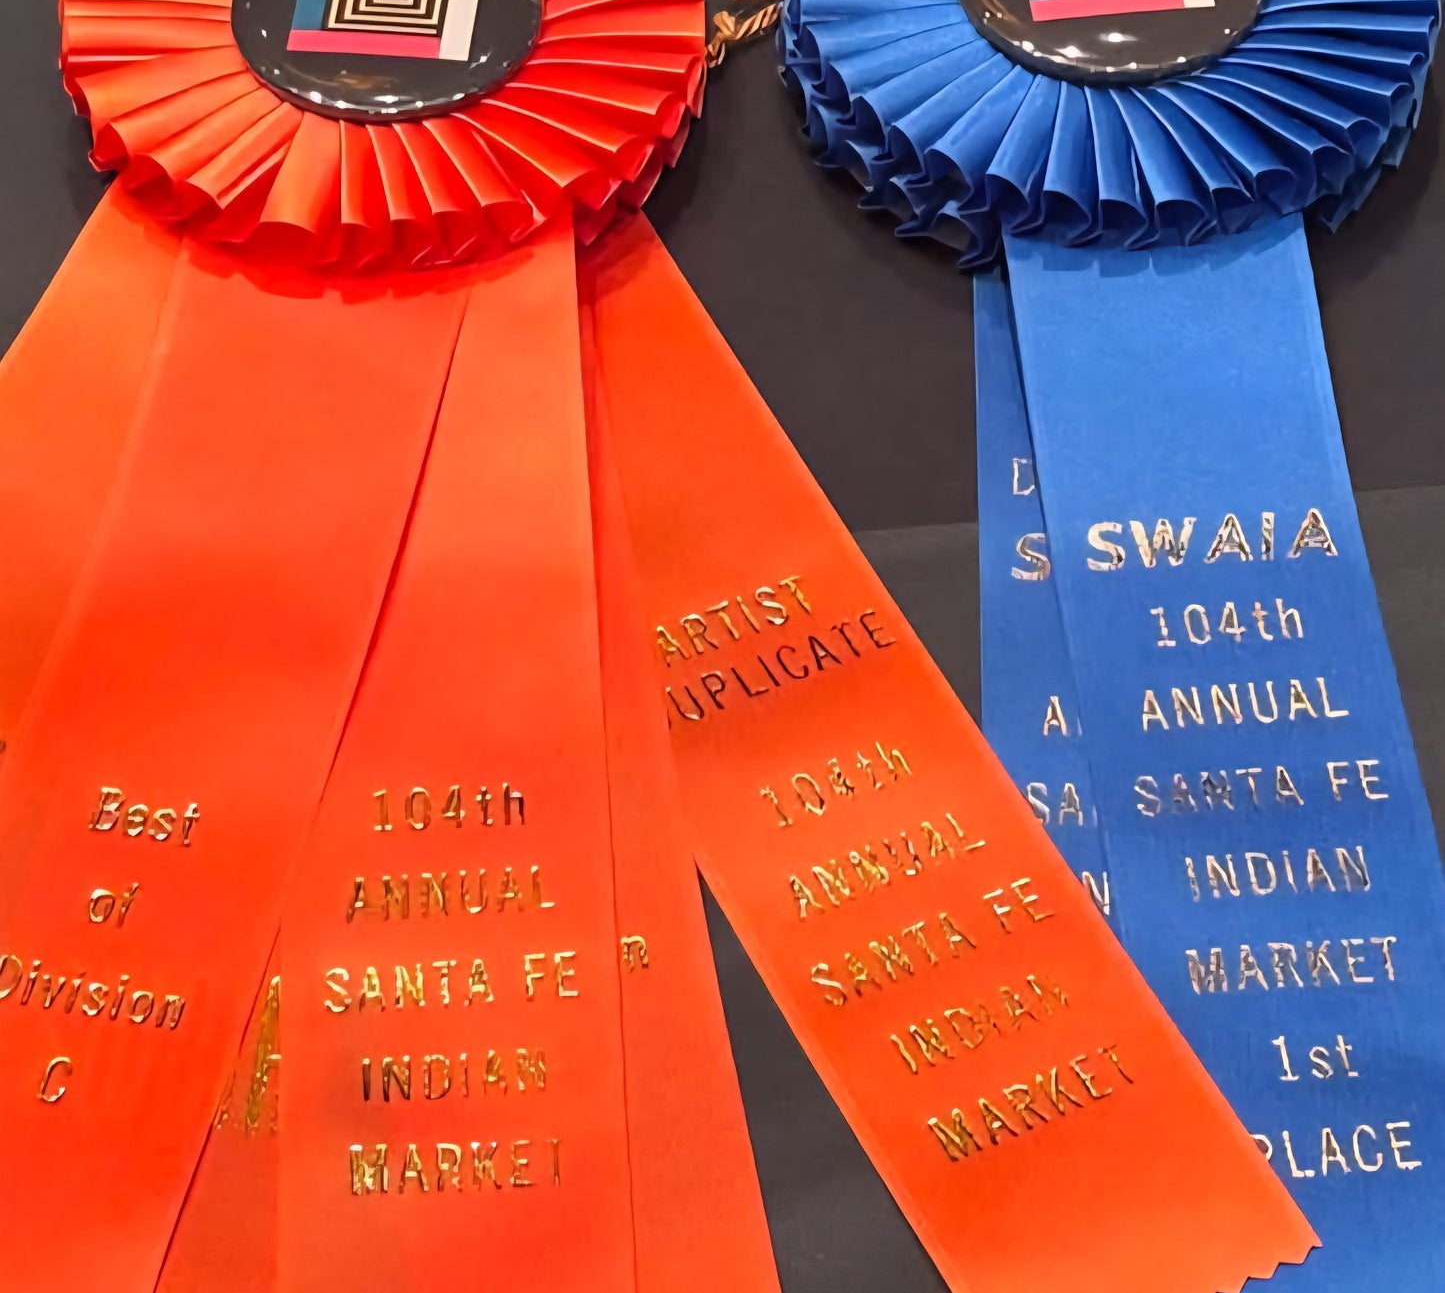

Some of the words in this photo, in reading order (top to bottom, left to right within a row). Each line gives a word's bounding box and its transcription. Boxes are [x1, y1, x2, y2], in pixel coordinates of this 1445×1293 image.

[1086, 508, 1338, 572] SWAIA
[656, 575, 811, 668] ARTIST
[1150, 598, 1304, 647] 104th
[665, 610, 898, 722] UPLICATE
[1142, 677, 1350, 731] ANNUAL
[372, 782, 525, 832] 104th
[760, 741, 912, 828] 104th
[1134, 765, 1304, 817] SANTA
[1326, 759, 1389, 801] FE
[88, 787, 201, 846] Best
[346, 865, 556, 923] ANNUAL
[790, 813, 986, 920] ANNUAL
[1184, 846, 1371, 902] INDIAN
[810, 912, 976, 1006] SANTA
[983, 877, 1055, 934] FE
[1186, 936, 1397, 995] MARKET
[0, 954, 186, 1030] Division
[324, 958, 494, 1013] SANTA
[524, 951, 580, 1002] FE
[37, 1056, 73, 1102] C
[361, 1048, 547, 1103] INDIAN
[1272, 1034, 1359, 1081] 1st
[927, 1044, 1136, 1162] MARKET
[349, 1138, 563, 1195] MARKET
